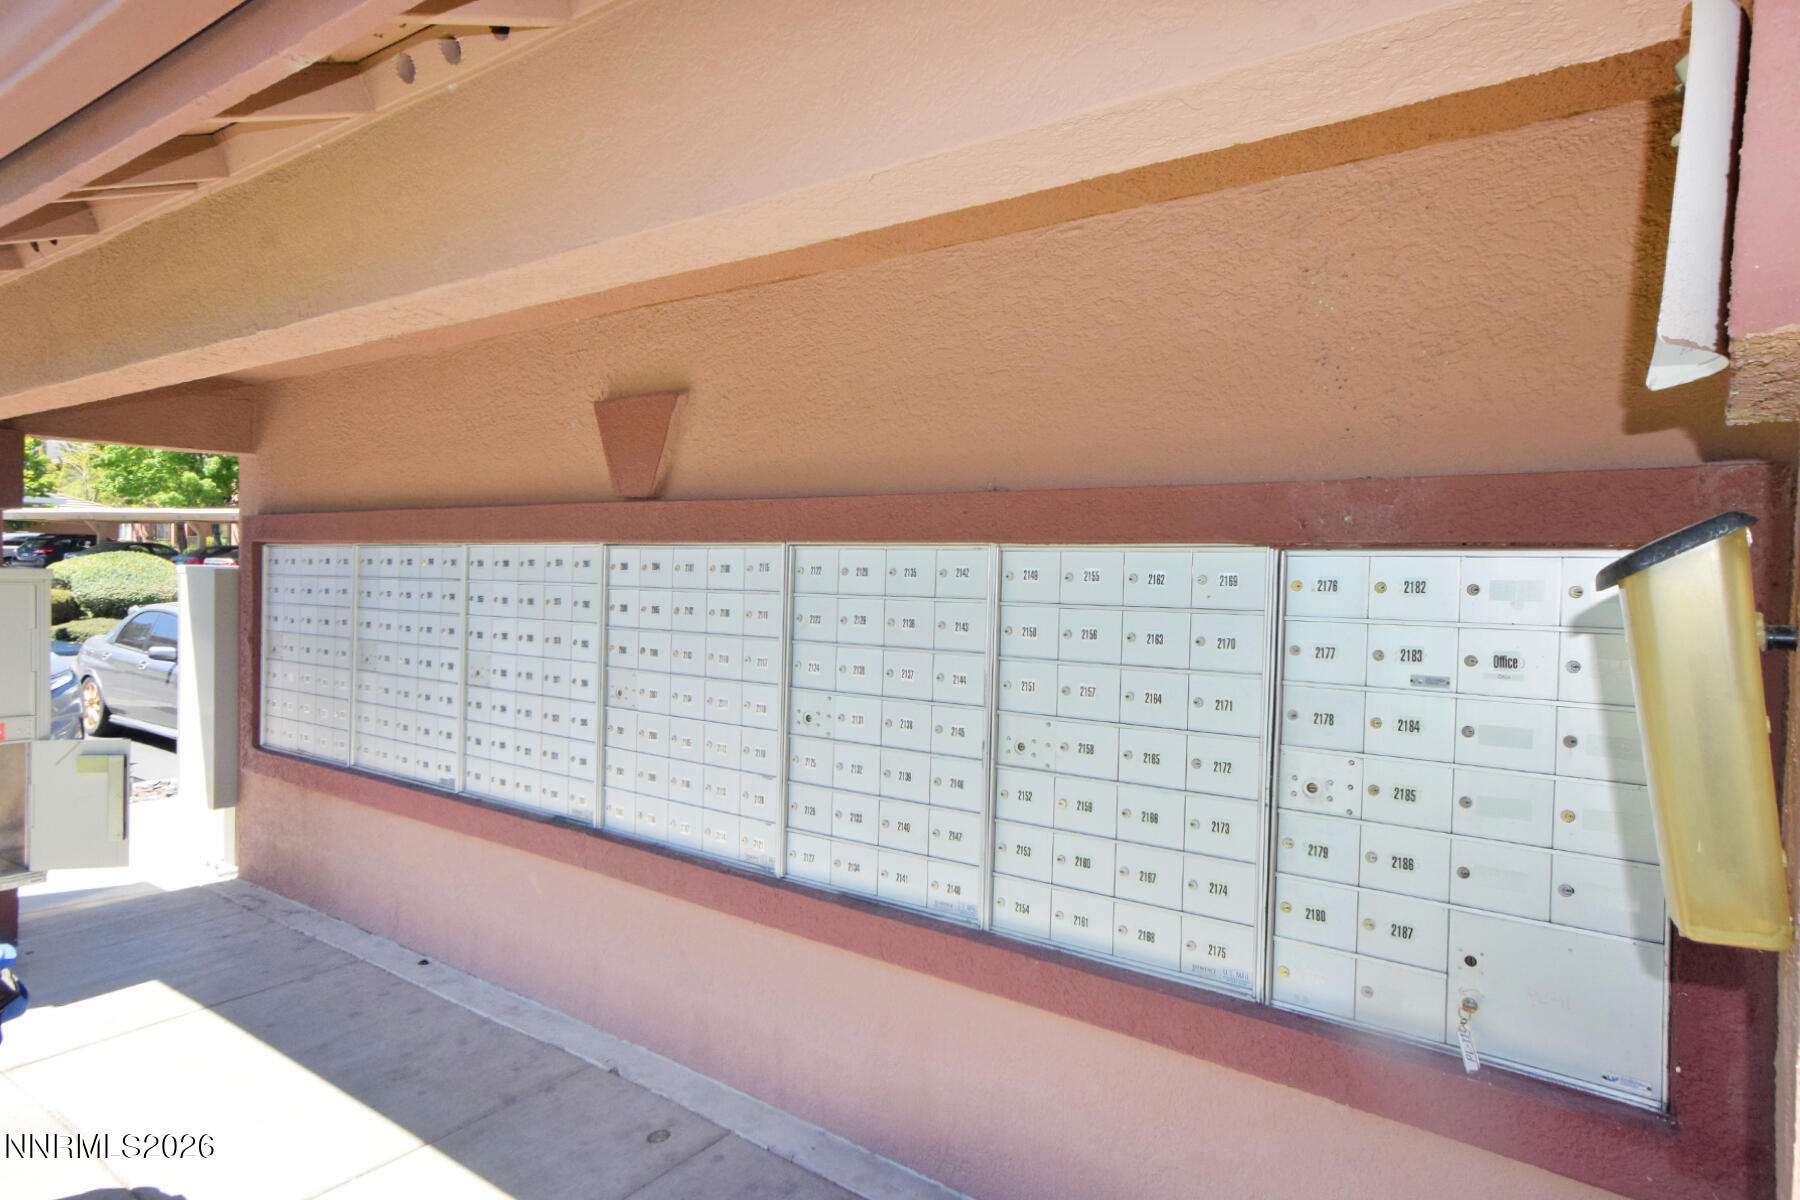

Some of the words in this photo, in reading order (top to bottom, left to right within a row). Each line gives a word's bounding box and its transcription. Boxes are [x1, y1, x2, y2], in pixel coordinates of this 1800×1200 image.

[1083, 570, 1100, 582] 2155
[1147, 573, 1166, 586] 2162
[1316, 579, 1338, 593] 2176
[1403, 580, 1427, 594] 2182
[1022, 626, 1038, 638] 2150
[1146, 632, 1164, 646] 2163
[1216, 637, 1236, 650] 2170
[1314, 646, 1336, 660] 2177
[1400, 648, 1424, 663] 2183
[1493, 654, 1518, 670] Office
[1021, 680, 1036, 692] 2151
[1079, 685, 1097, 698] 2157
[1144, 692, 1162, 705] 2164
[1215, 698, 1233, 712] 2171
[1313, 712, 1335, 727] 2178
[1397, 718, 1421, 734] 2184
[1143, 752, 1161, 766] 2165
[1213, 760, 1232, 774] 2172
[1018, 789, 1033, 802] 2152
[1393, 786, 1417, 803] 2185
[1211, 820, 1230, 835] 2173
[1016, 844, 1032, 858] 2153
[1307, 843, 1329, 860] 2179
[1391, 855, 1414, 872] 2186
[1209, 882, 1228, 897] 2174
[1014, 901, 1030, 915] 2154
[1305, 907, 1326, 923] 2180
[1390, 923, 1414, 940] 2187
[1208, 944, 1226, 959] 2175
